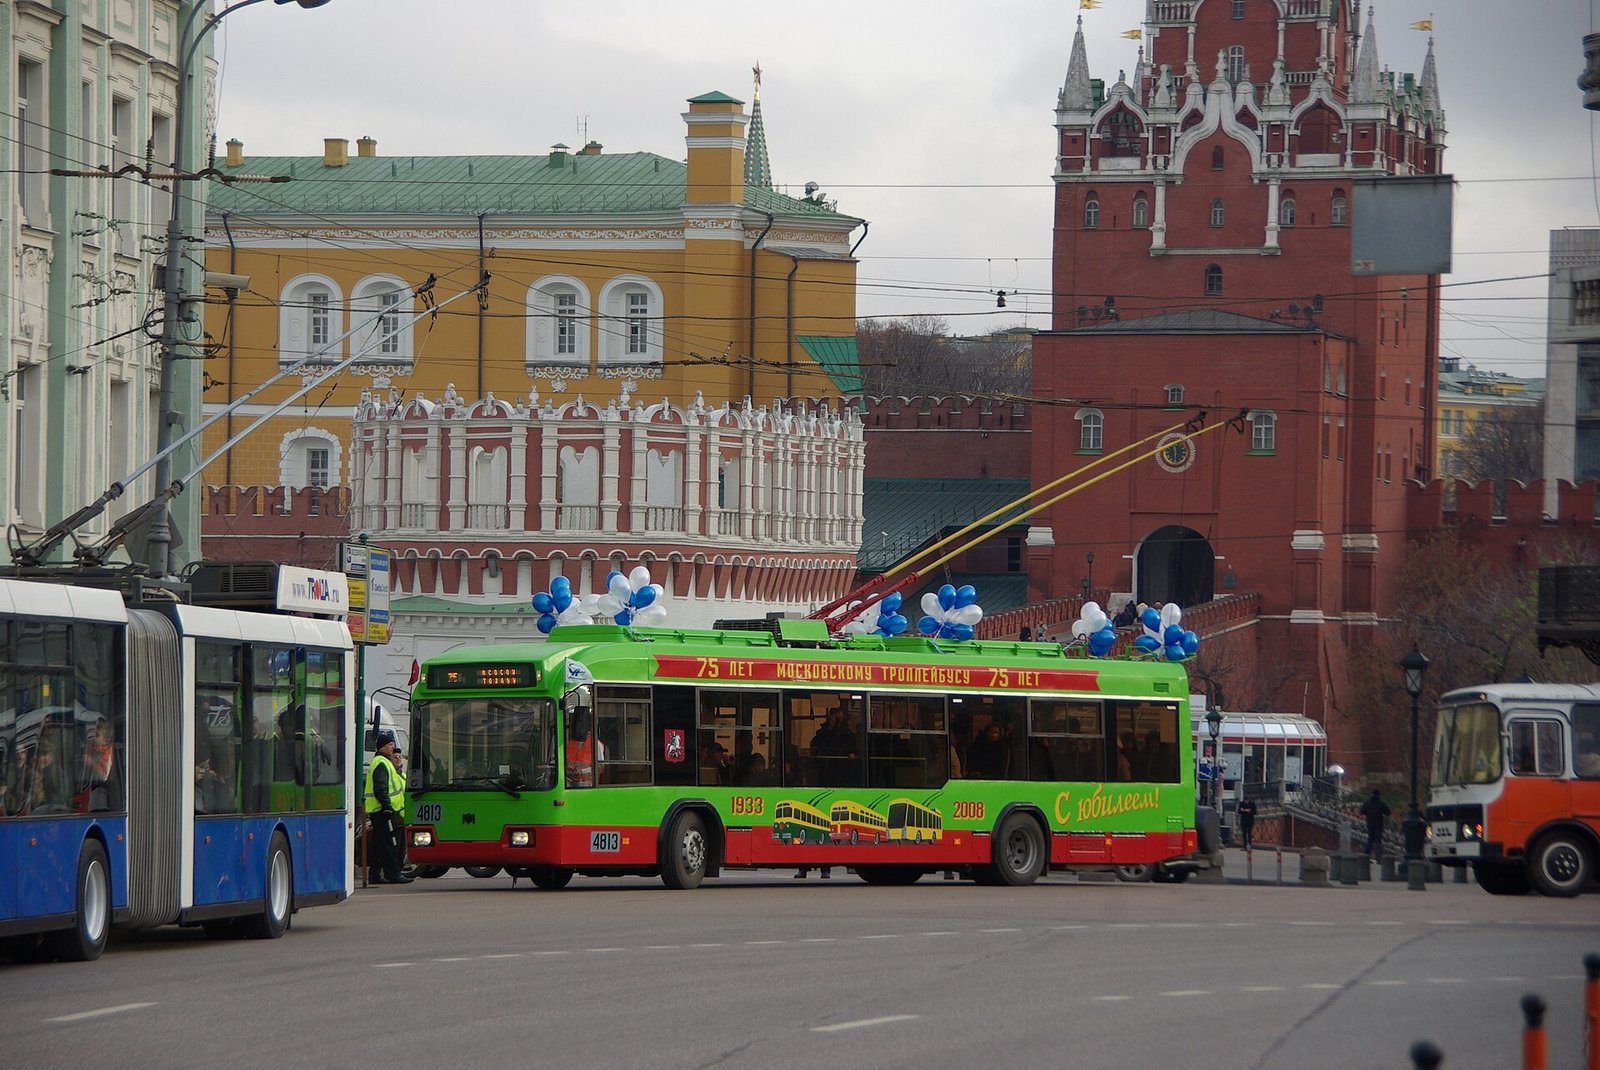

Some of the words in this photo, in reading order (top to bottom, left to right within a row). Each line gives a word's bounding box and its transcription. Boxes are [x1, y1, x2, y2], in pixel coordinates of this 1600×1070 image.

[696, 658, 720, 678] 75
[729, 661, 754, 677] ЛЕТ
[776, 662, 872, 681] МОСКОВСКОМУ
[881, 666, 971, 685] ТРОЛЛЕЙБУСУ
[988, 667, 1010, 688] 75
[1018, 671, 1041, 687] ЛЕТ
[416, 803, 442, 822] 4813
[730, 795, 765, 816] 1933
[952, 800, 987, 821] 2008
[1054, 791, 1072, 826] С
[1076, 782, 1160, 824] юбилеем!
[592, 832, 619, 850] 4813
